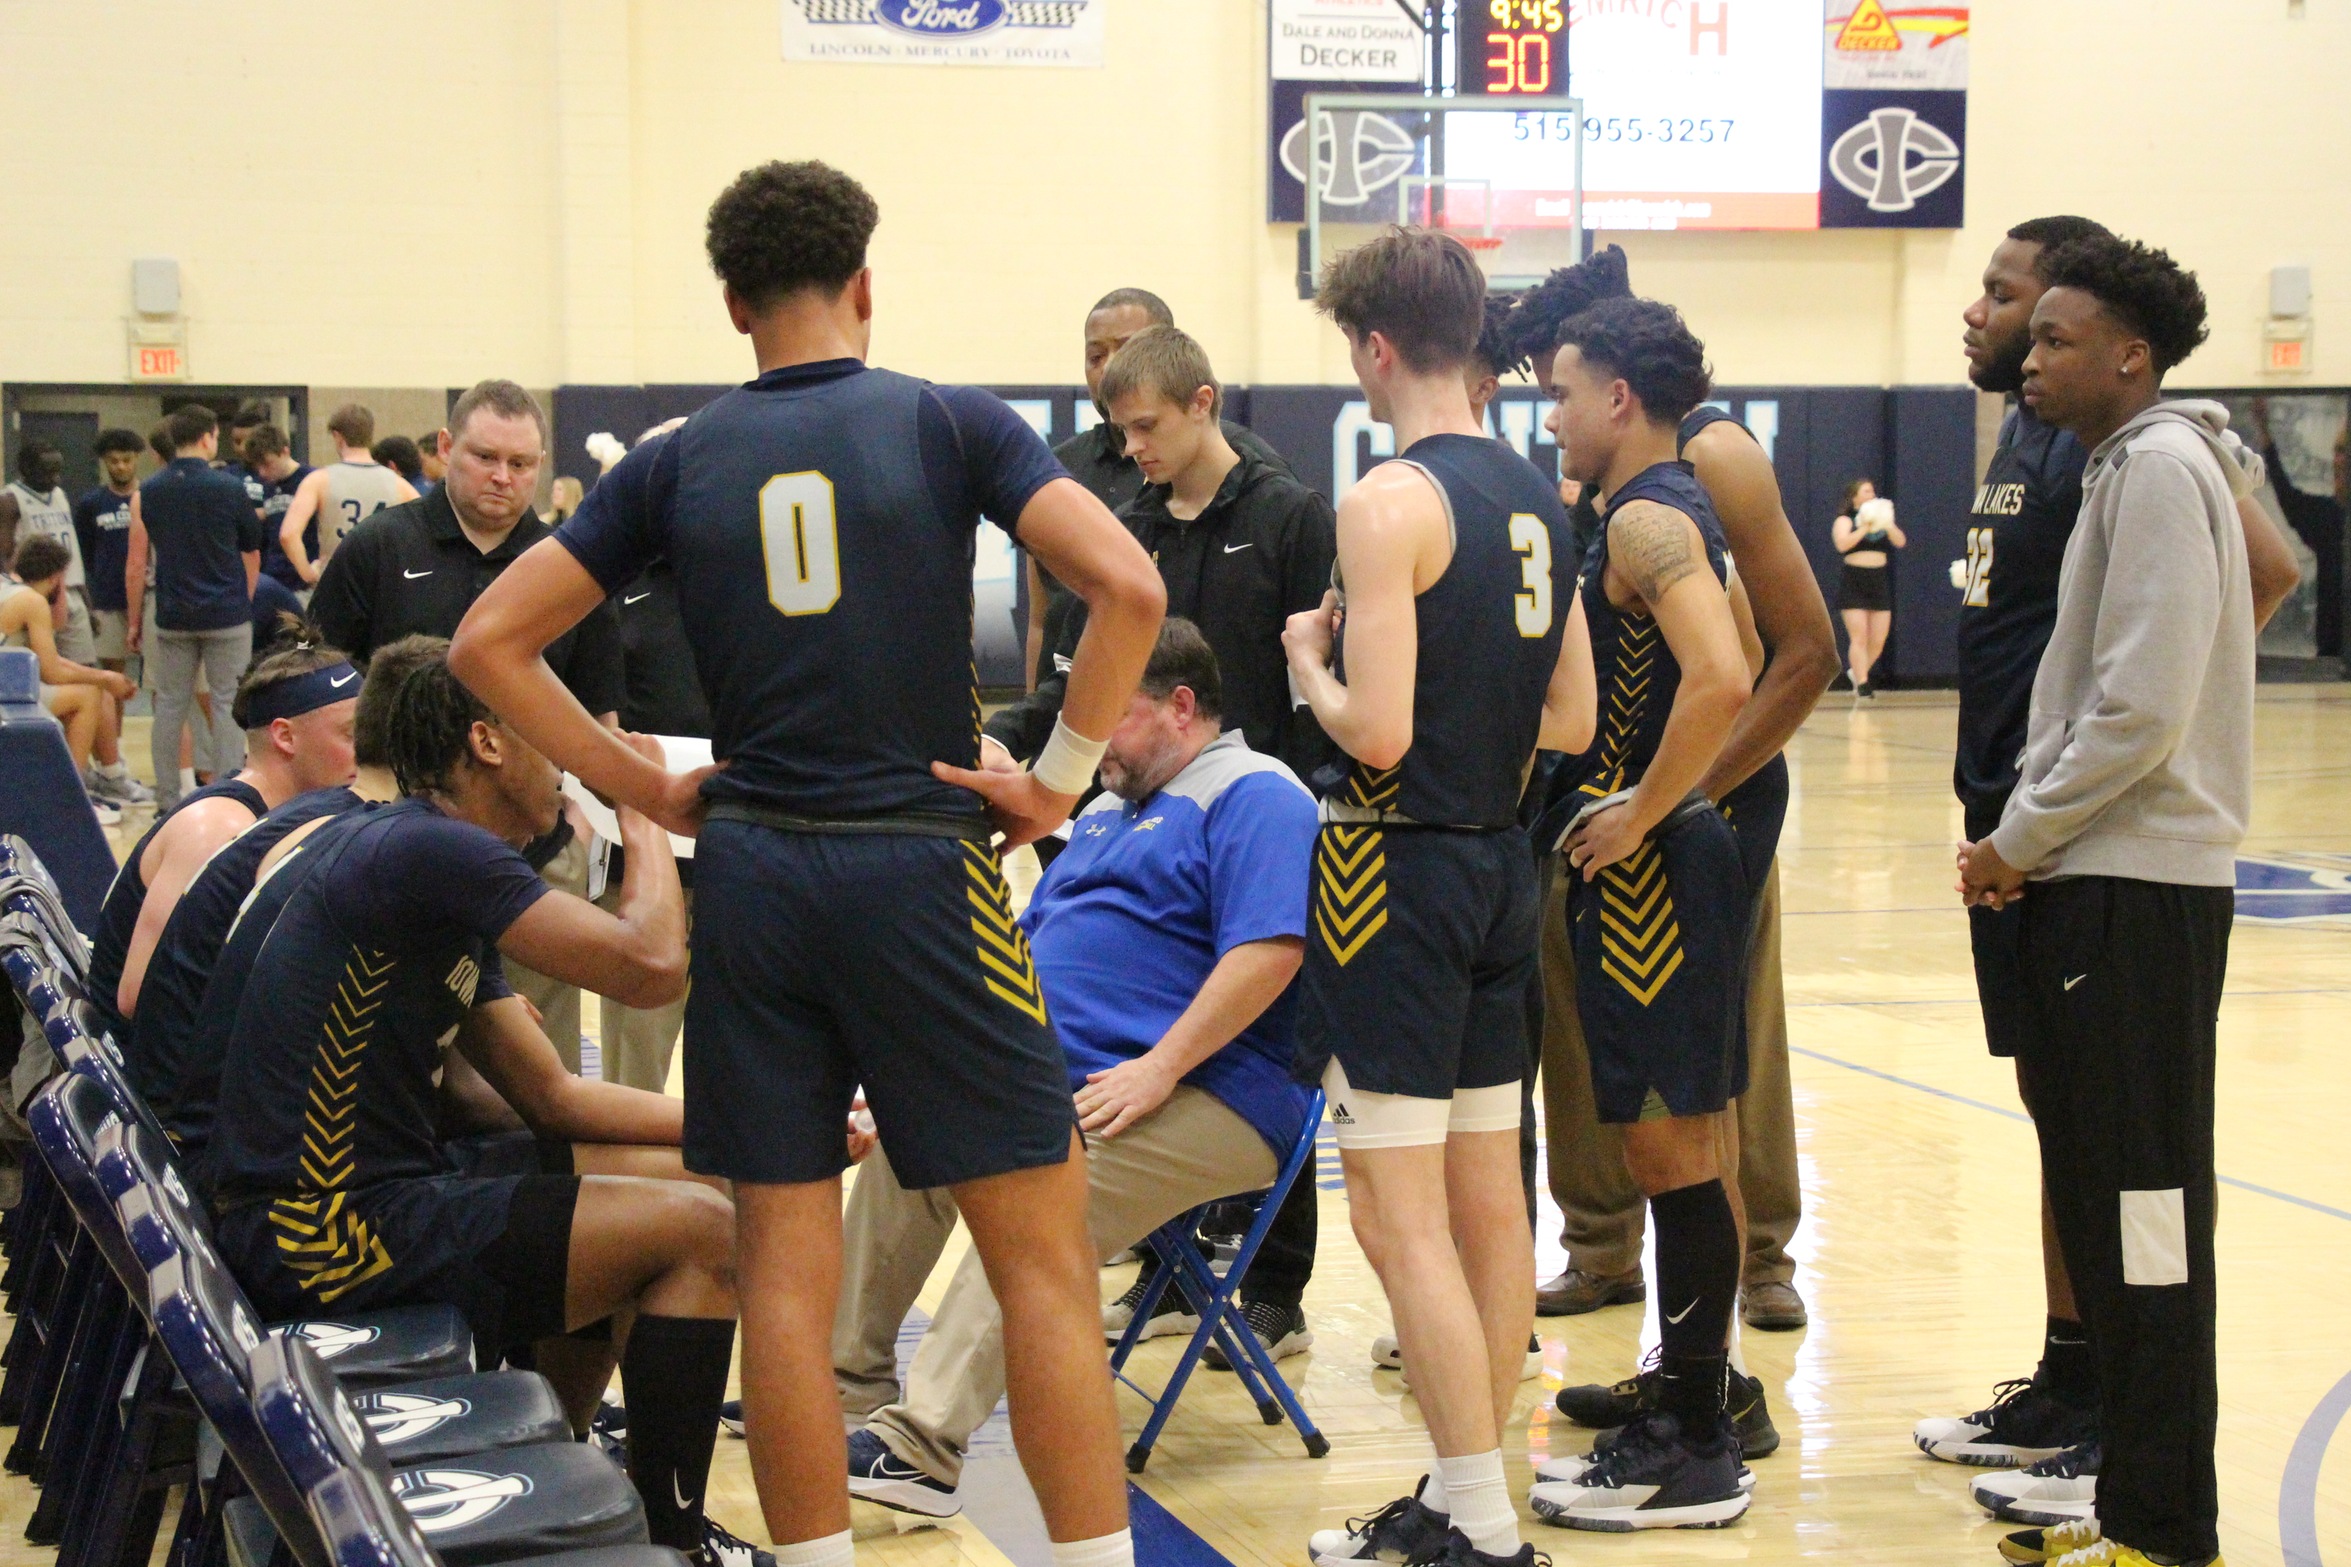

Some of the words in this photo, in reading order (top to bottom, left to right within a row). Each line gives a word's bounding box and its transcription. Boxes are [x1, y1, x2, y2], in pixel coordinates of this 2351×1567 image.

[901, 0, 981, 30] Ford
[1490, 0, 1563, 32] 9:45
[810, 43, 891, 56] LINCOLN
[904, 45, 990, 59] MERCURY
[1004, 46, 1071, 60] TOYOTA
[1300, 43, 1397, 67] DECKER
[1487, 33, 1550, 93] 30
[140, 349, 176, 375] EXIT
[1983, 484, 2026, 515] LAKES
[336, 500, 387, 538] 3
[758, 469, 842, 617] 0
[1507, 512, 1553, 639] 3
[1333, 1116, 1356, 1125] didas
